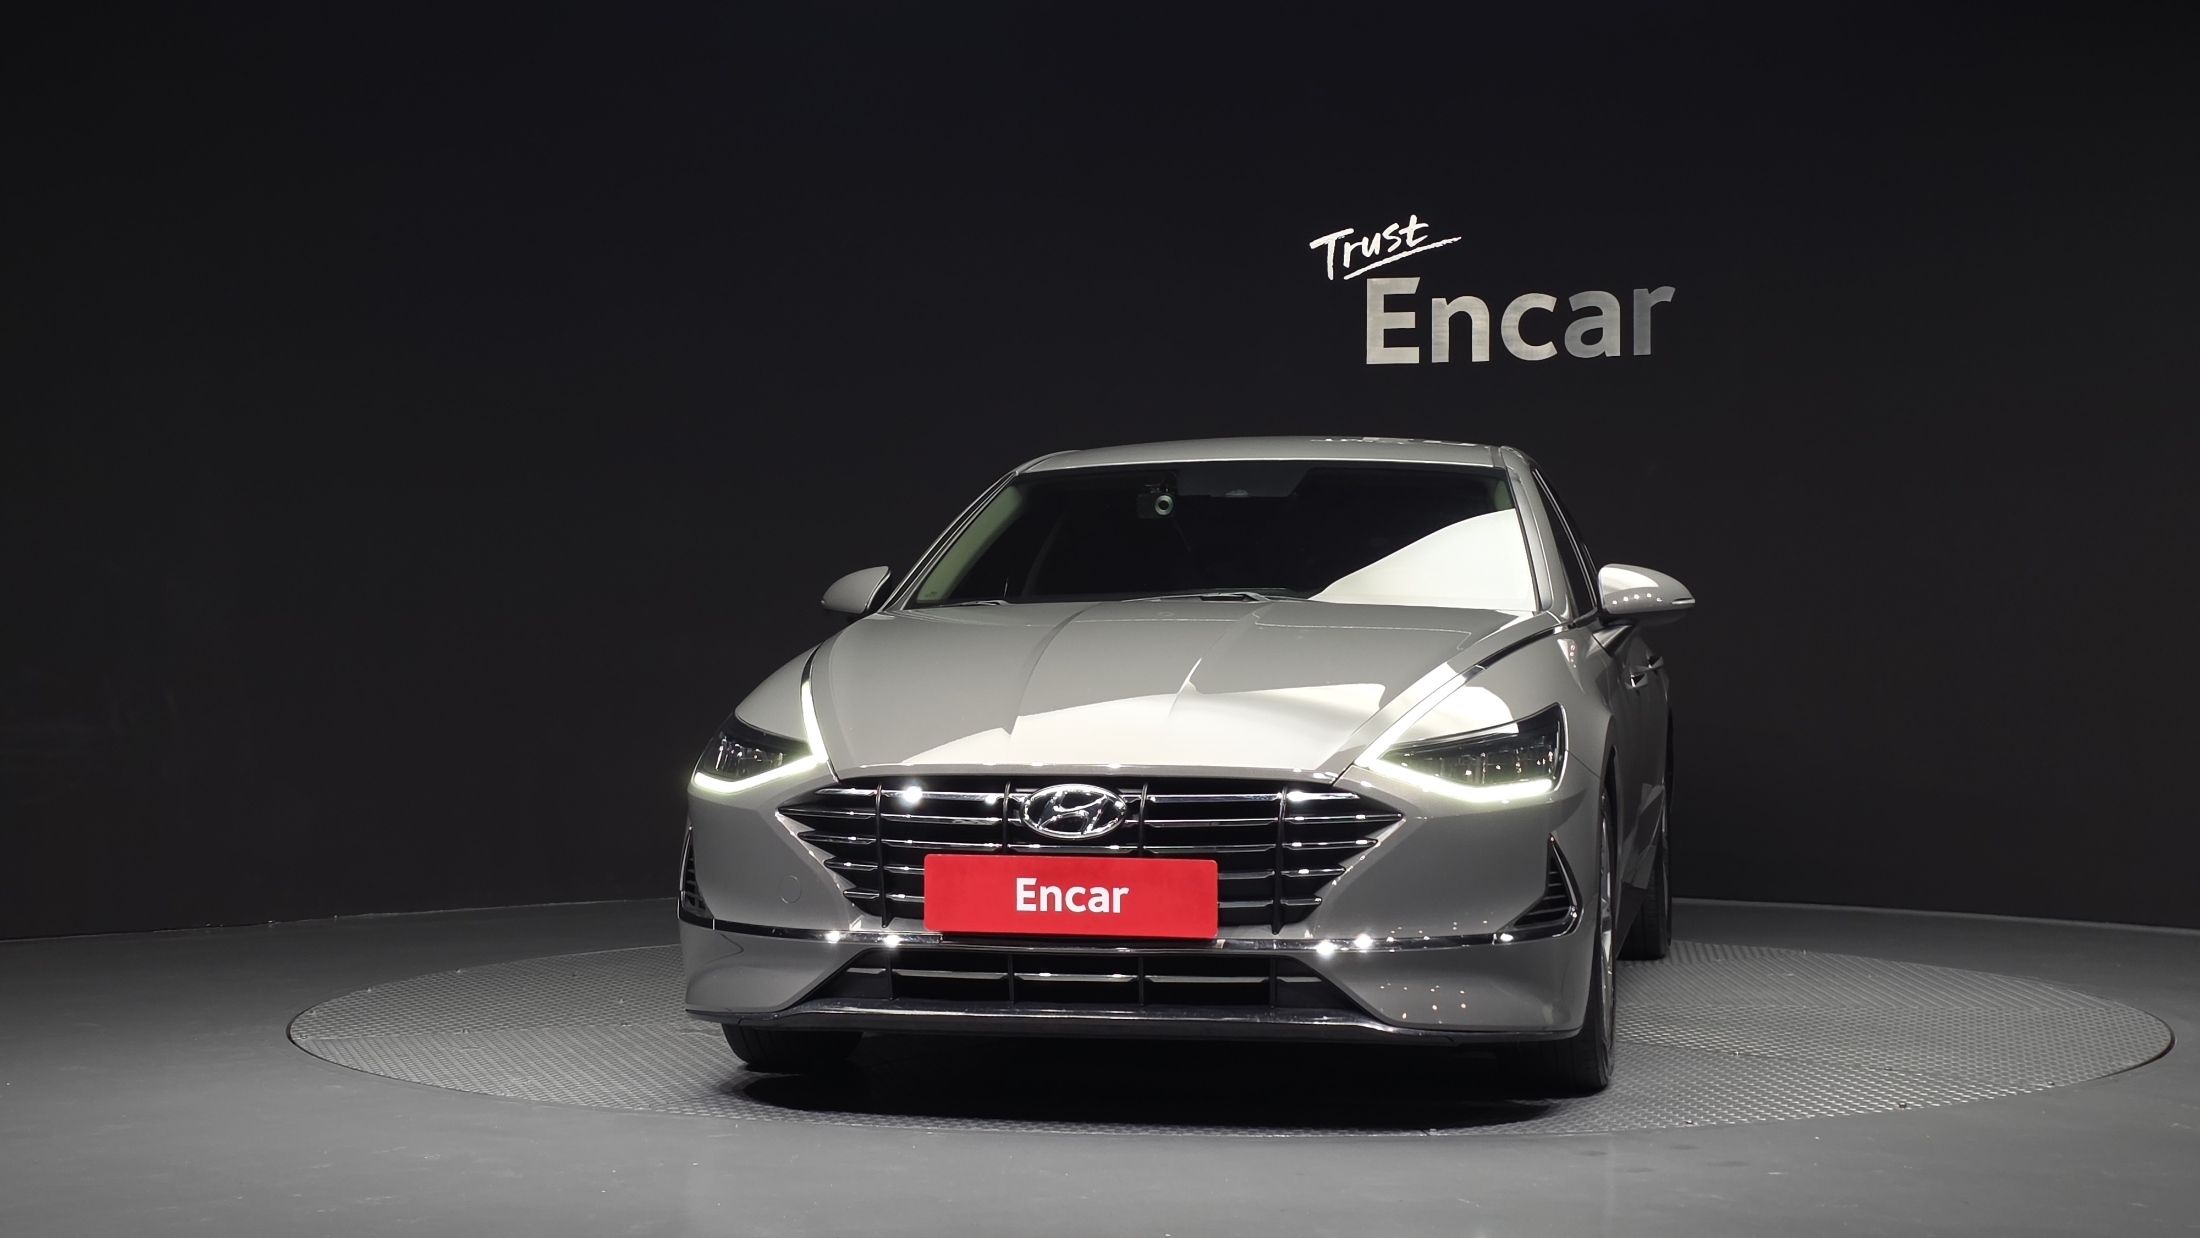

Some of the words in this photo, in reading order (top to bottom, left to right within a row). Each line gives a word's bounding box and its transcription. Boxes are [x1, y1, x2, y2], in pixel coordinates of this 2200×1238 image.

[1309, 214, 1430, 280] Trust
[1366, 277, 1676, 365] Encar
[1016, 877, 1129, 913] Encar
